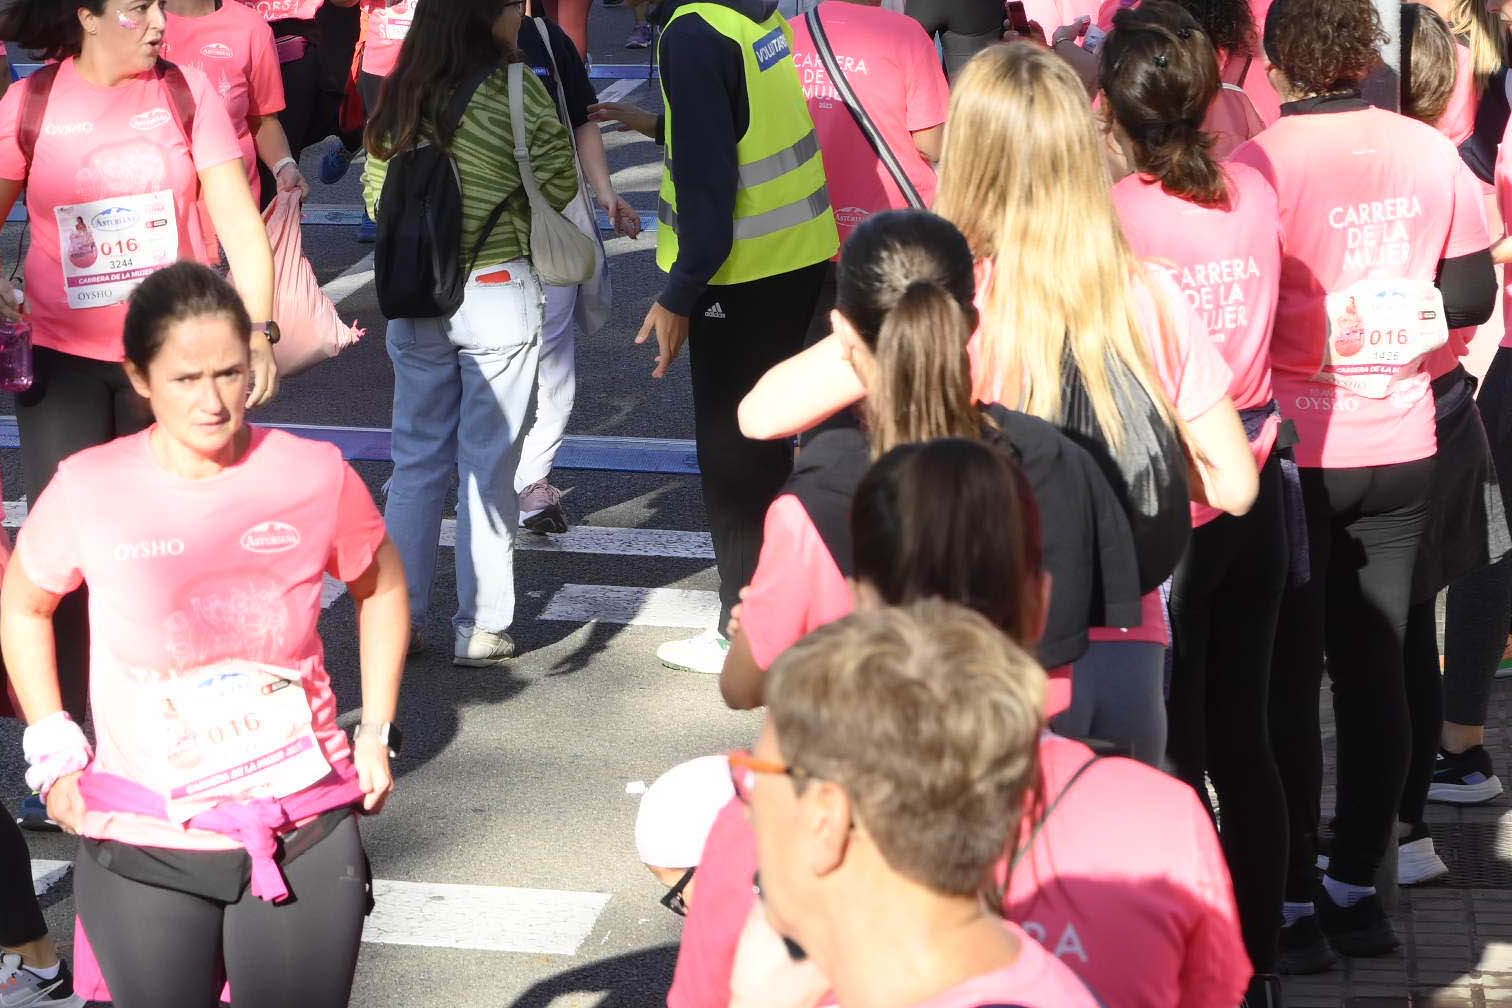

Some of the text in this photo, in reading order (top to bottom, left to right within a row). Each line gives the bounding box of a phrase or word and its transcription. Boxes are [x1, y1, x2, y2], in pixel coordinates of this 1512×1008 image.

[1329, 197, 1422, 229] CARRERA
[1382, 221, 1410, 242] LA
[101, 238, 138, 256] 016
[110, 258, 133, 269] 3244
[79, 273, 110, 285] CARRERA
[111, 273, 121, 281] DE
[122, 271, 131, 279] LA
[78, 289, 113, 301] OYSHO
[1219, 284, 1244, 304] LA
[1369, 329, 1408, 346] 016
[1296, 395, 1359, 410] OYSHO
[113, 538, 185, 561] OYSHO
[208, 713, 261, 744] 016
